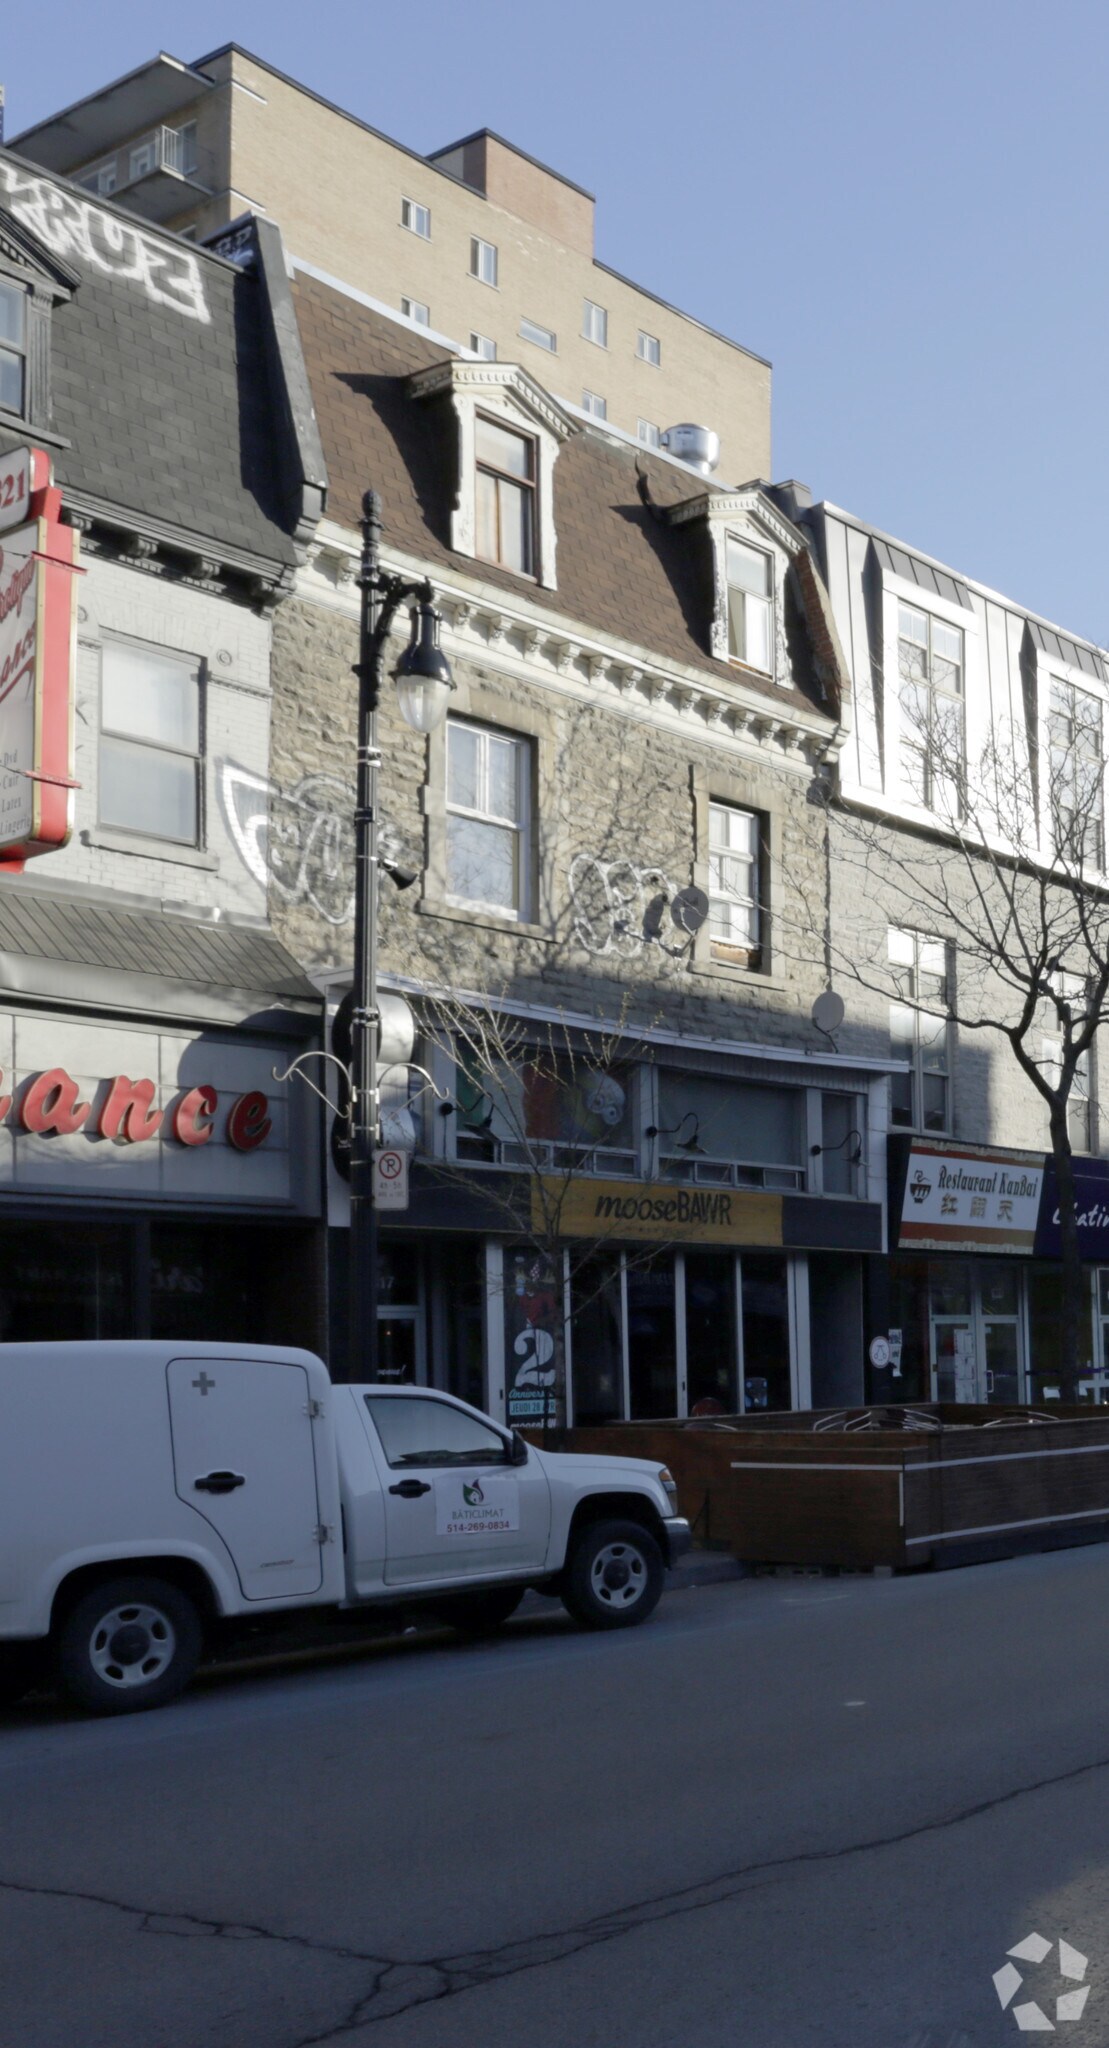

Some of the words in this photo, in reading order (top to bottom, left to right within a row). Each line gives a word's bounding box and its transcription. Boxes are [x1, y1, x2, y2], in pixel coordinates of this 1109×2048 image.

[0, 469, 25, 508] 21
[0, 1065, 273, 1152] ance
[938, 1165, 997, 1193] Restaurant
[594, 1190, 732, 1226] mooseBAWR
[512, 1402, 531, 1413] JEUDI
[447, 1520, 510, 1533] 514-269-0834
